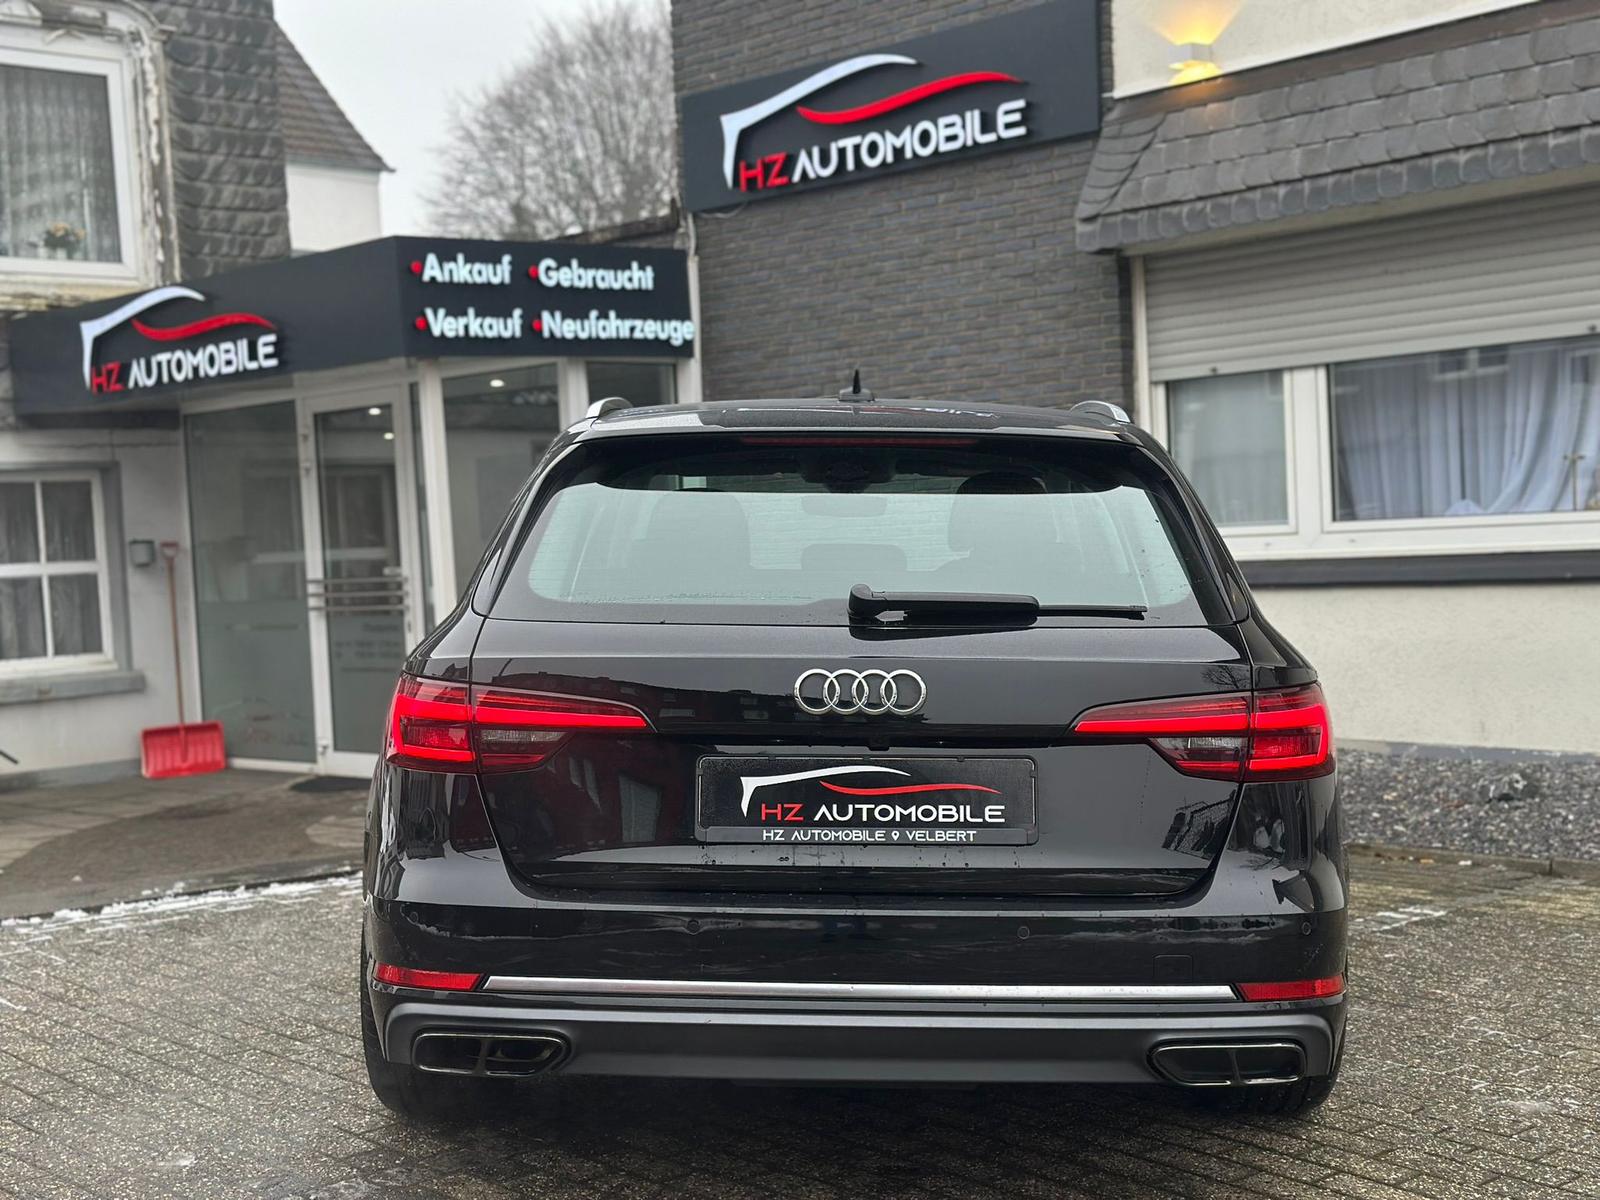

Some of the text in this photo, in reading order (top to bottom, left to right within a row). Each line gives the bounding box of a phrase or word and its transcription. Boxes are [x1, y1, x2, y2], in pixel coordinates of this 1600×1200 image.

[739, 99, 1027, 192] HZ AUTOMOBILE
[422, 253, 512, 284] Ankauf
[538, 257, 654, 290] Gebraucht
[425, 307, 523, 338] Verkauf
[541, 309, 695, 346] Neufahrzeuge
[91, 333, 279, 395] HZ AUTOMOBILE
[761, 803, 1006, 823] HZ AUTOMOBILE
[762, 829, 977, 842] HZ AUTOMOBILE VELBERT
